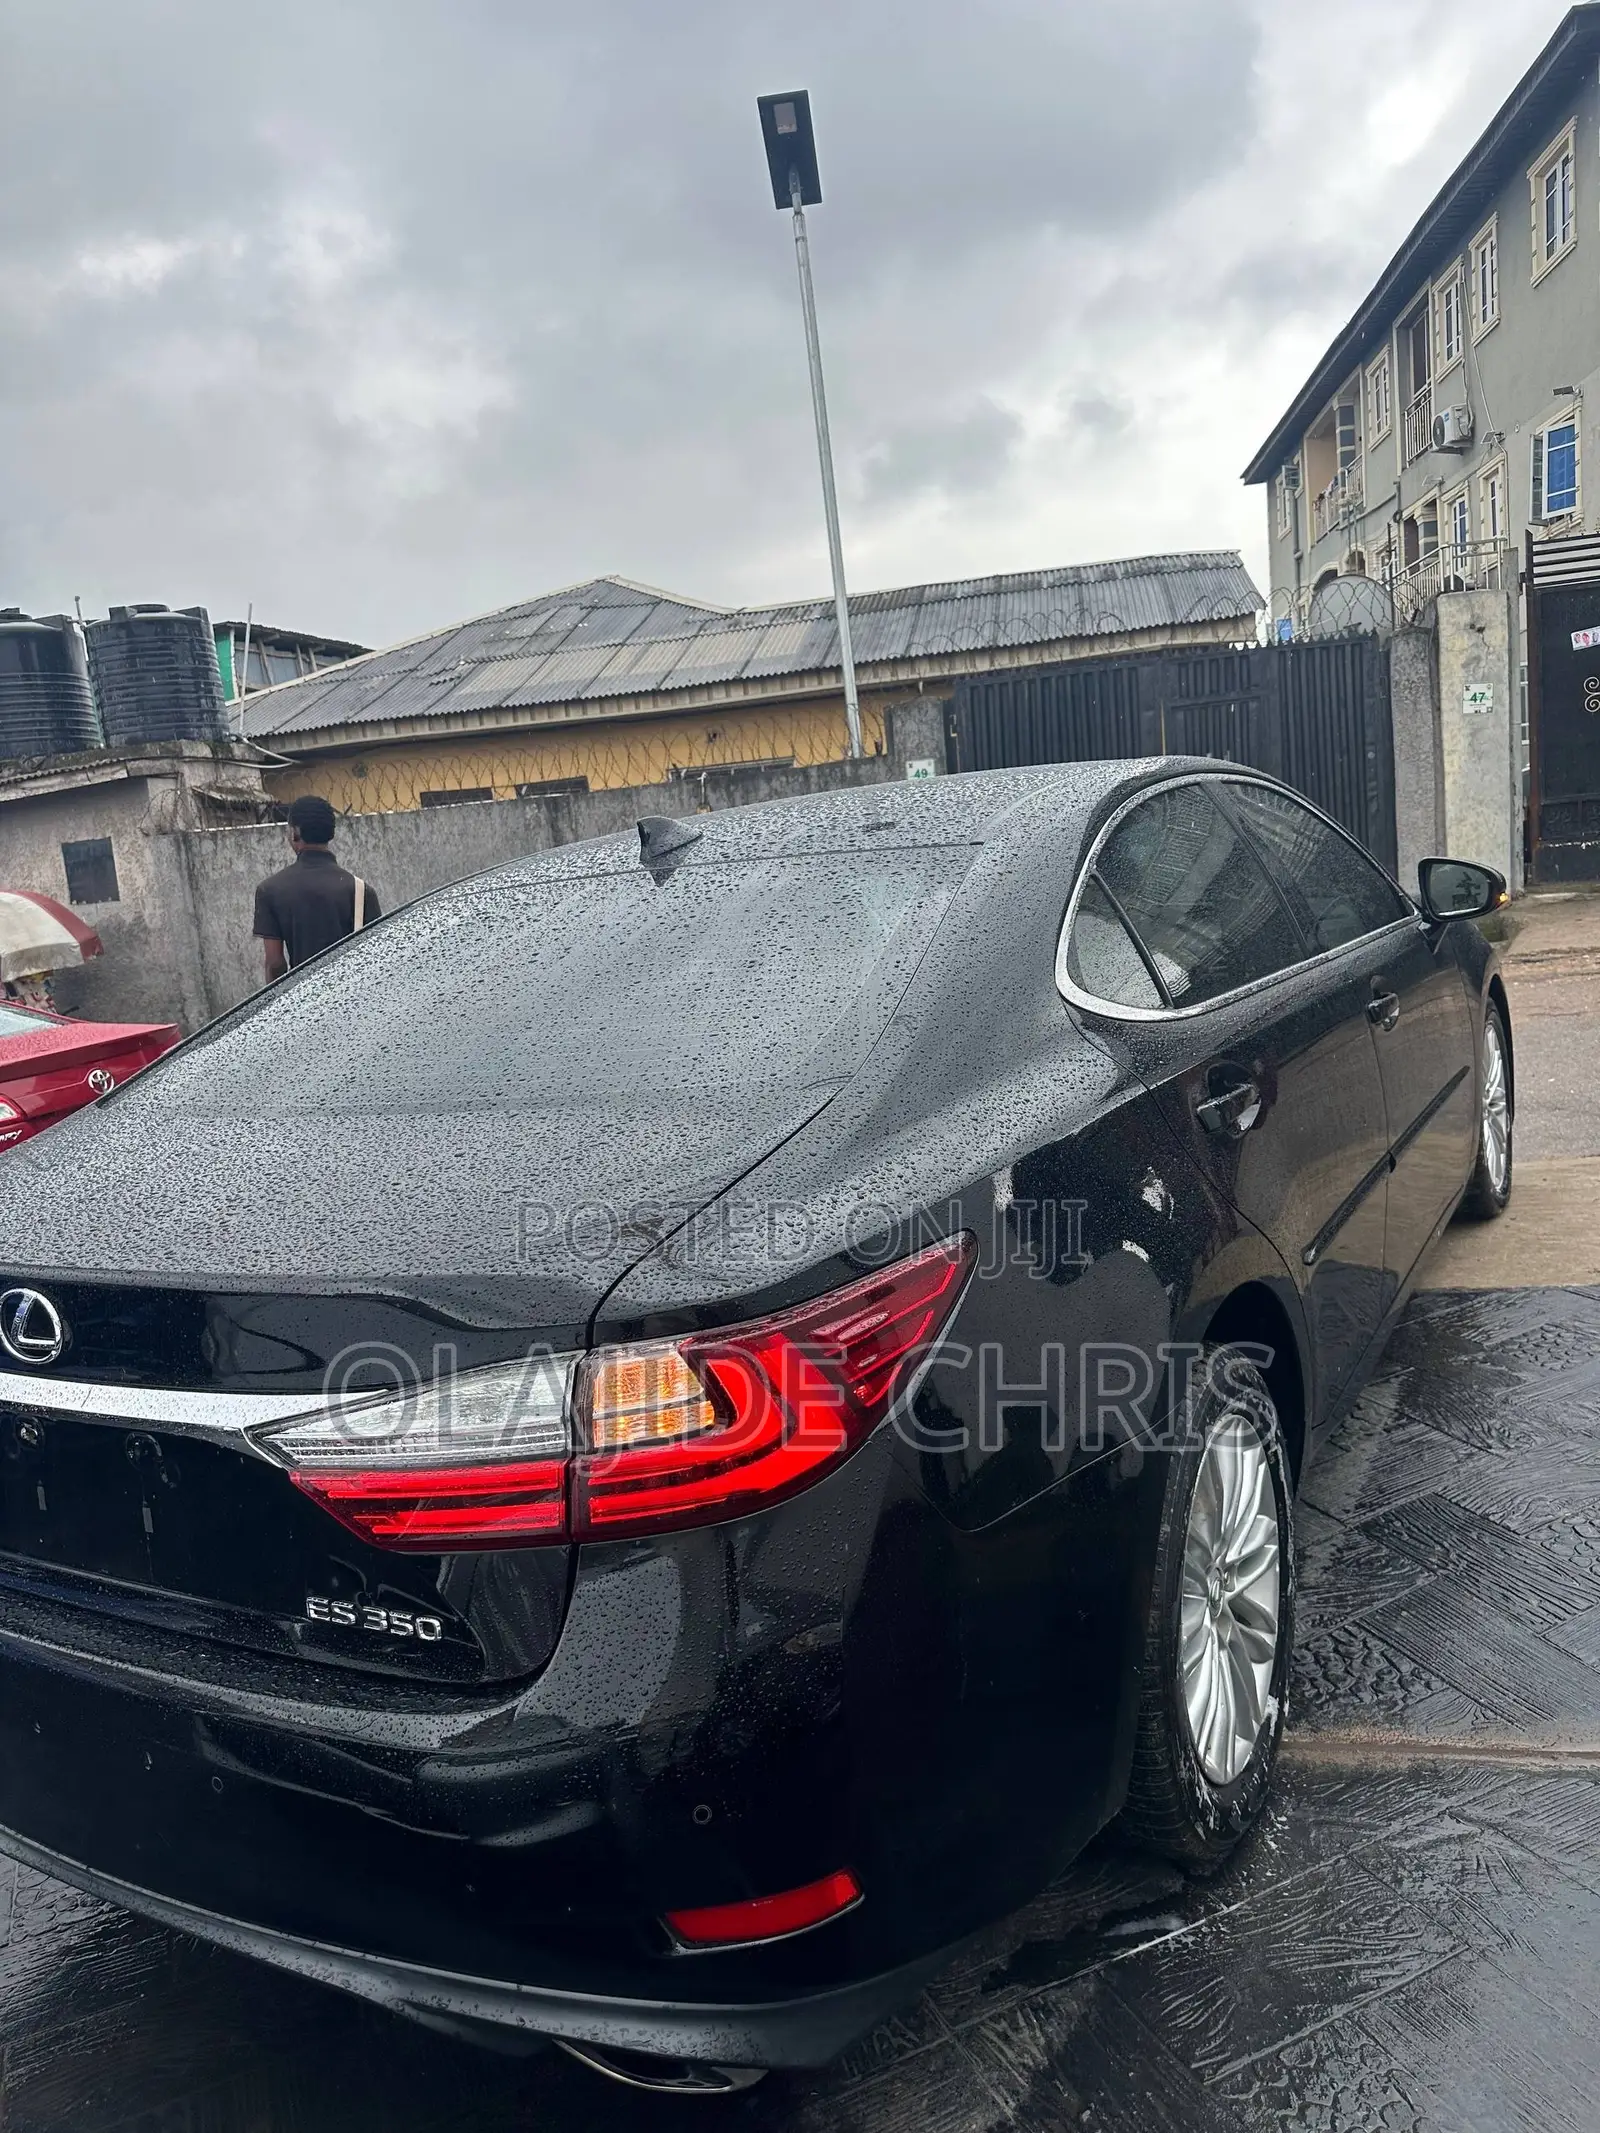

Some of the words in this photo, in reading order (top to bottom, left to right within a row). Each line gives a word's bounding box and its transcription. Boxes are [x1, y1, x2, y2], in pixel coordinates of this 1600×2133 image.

[1470, 691, 1485, 703] 47
[914, 768, 928, 778] 49
[305, 1596, 357, 1625] ES
[362, 1606, 443, 1641] 350
